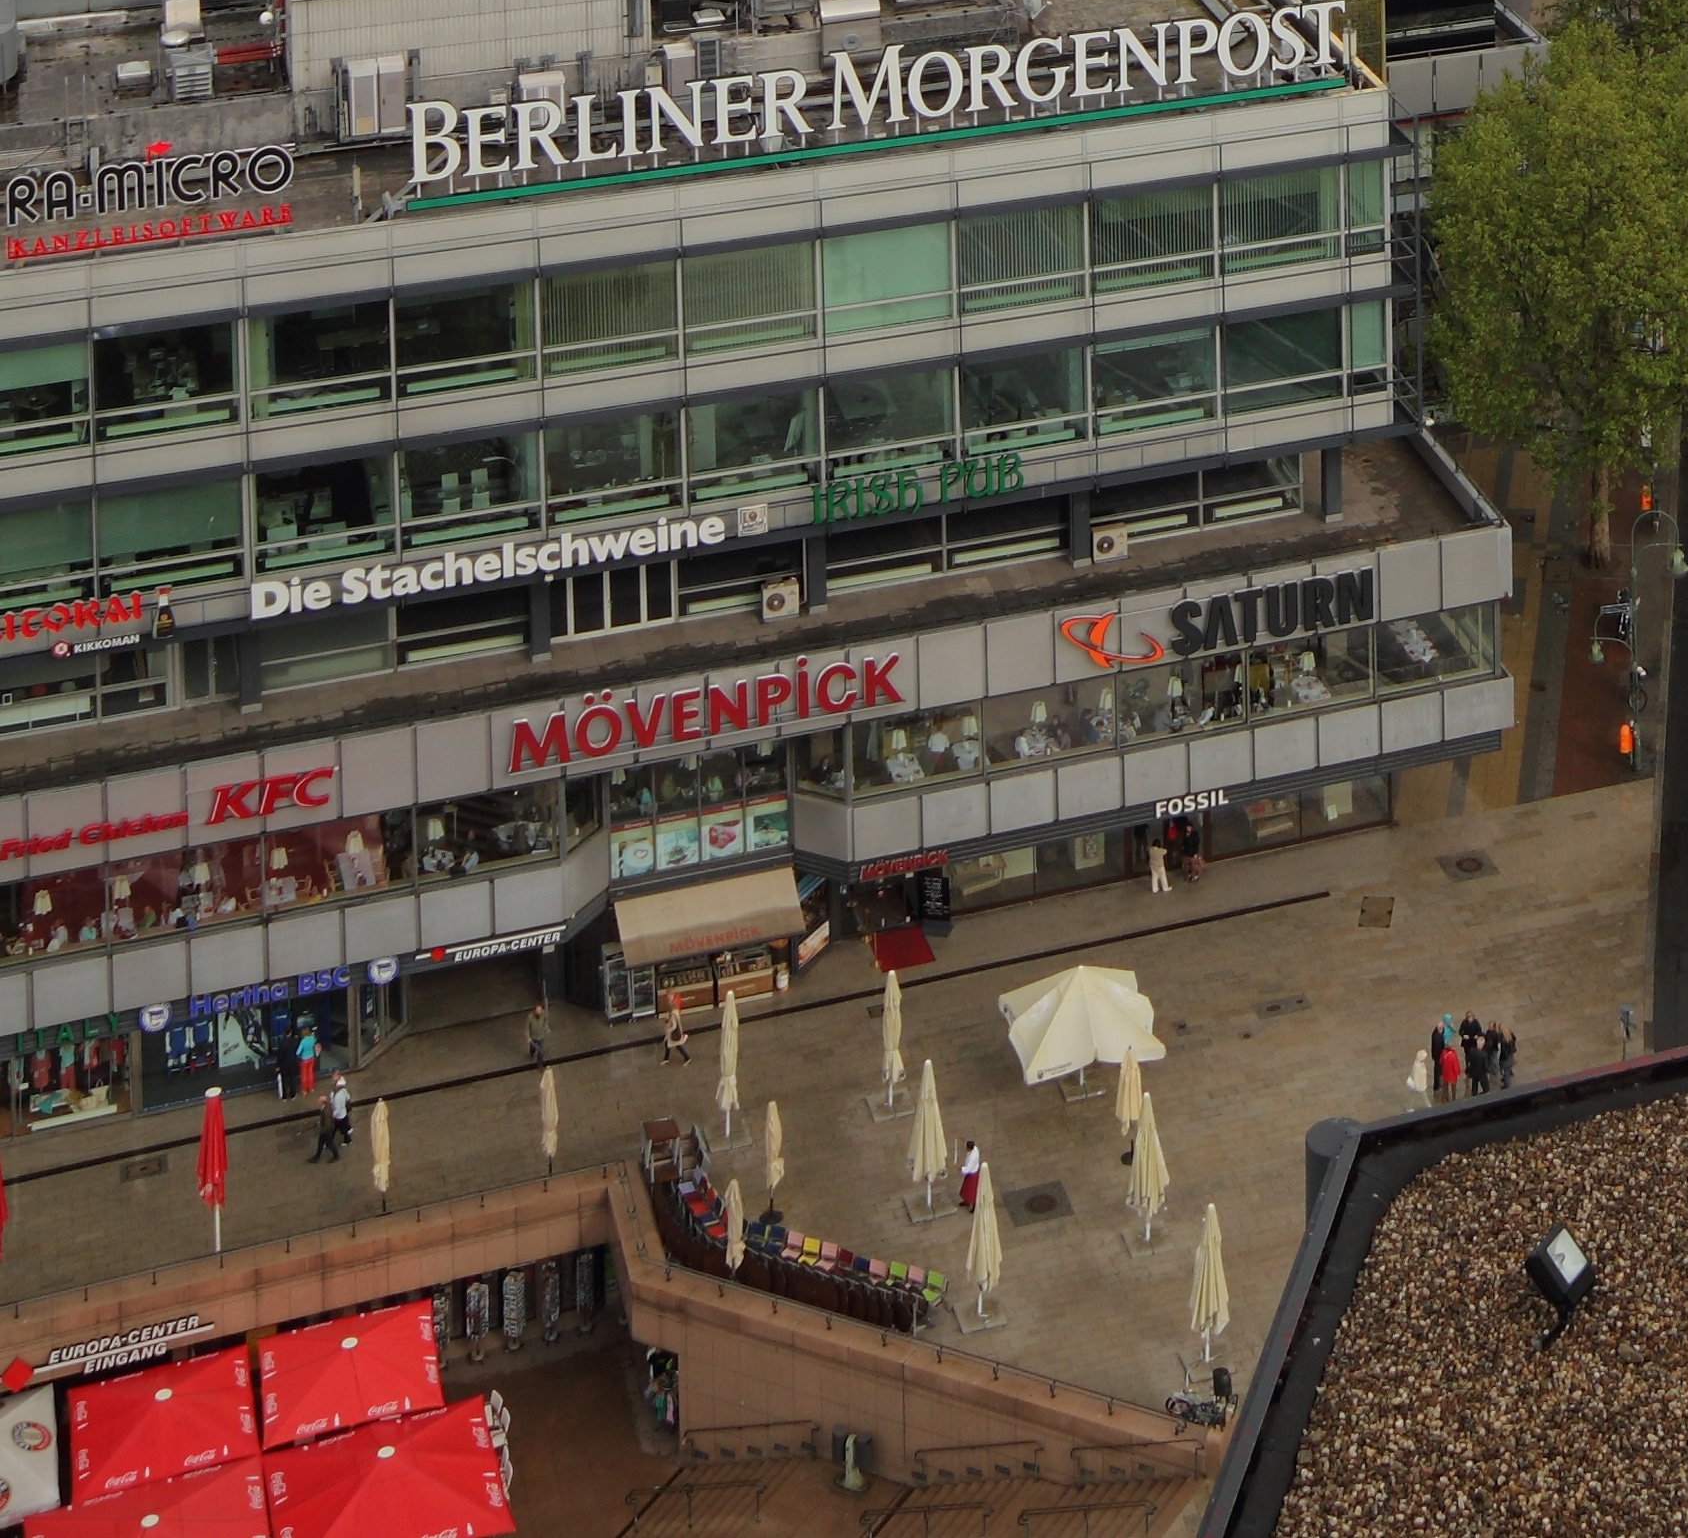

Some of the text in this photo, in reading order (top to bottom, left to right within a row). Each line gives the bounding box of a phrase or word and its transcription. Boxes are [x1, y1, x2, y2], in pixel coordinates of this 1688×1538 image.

[407, 0, 1346, 185] BERLINER MORGENPOST
[7, 203, 293, 260] KANZLEISOFTWARE
[811, 451, 1024, 525] IRISH PUB
[251, 514, 726, 620] Die Stachelschweine
[0, 590, 142, 642] ITOKAI
[1171, 567, 1374, 657] SATURN
[74, 634, 140, 654] KIKKOMAN
[508, 651, 905, 775] MÖVENPICK
[0, 766, 335, 861] Fried Chicken KFC
[1155, 789, 1229, 819] FOSSIL
[859, 848, 949, 881] MÖVENPICK
[455, 932, 561, 963] EUROPA-CENTER
[669, 926, 761, 954] MÖVENPICK
[190, 966, 350, 1017] Hertha BSC
[16, 1013, 121, 1052] ITALY
[49, 1315, 200, 1365] EUROPA-CENTER
[84, 1342, 167, 1374] EINGANG
